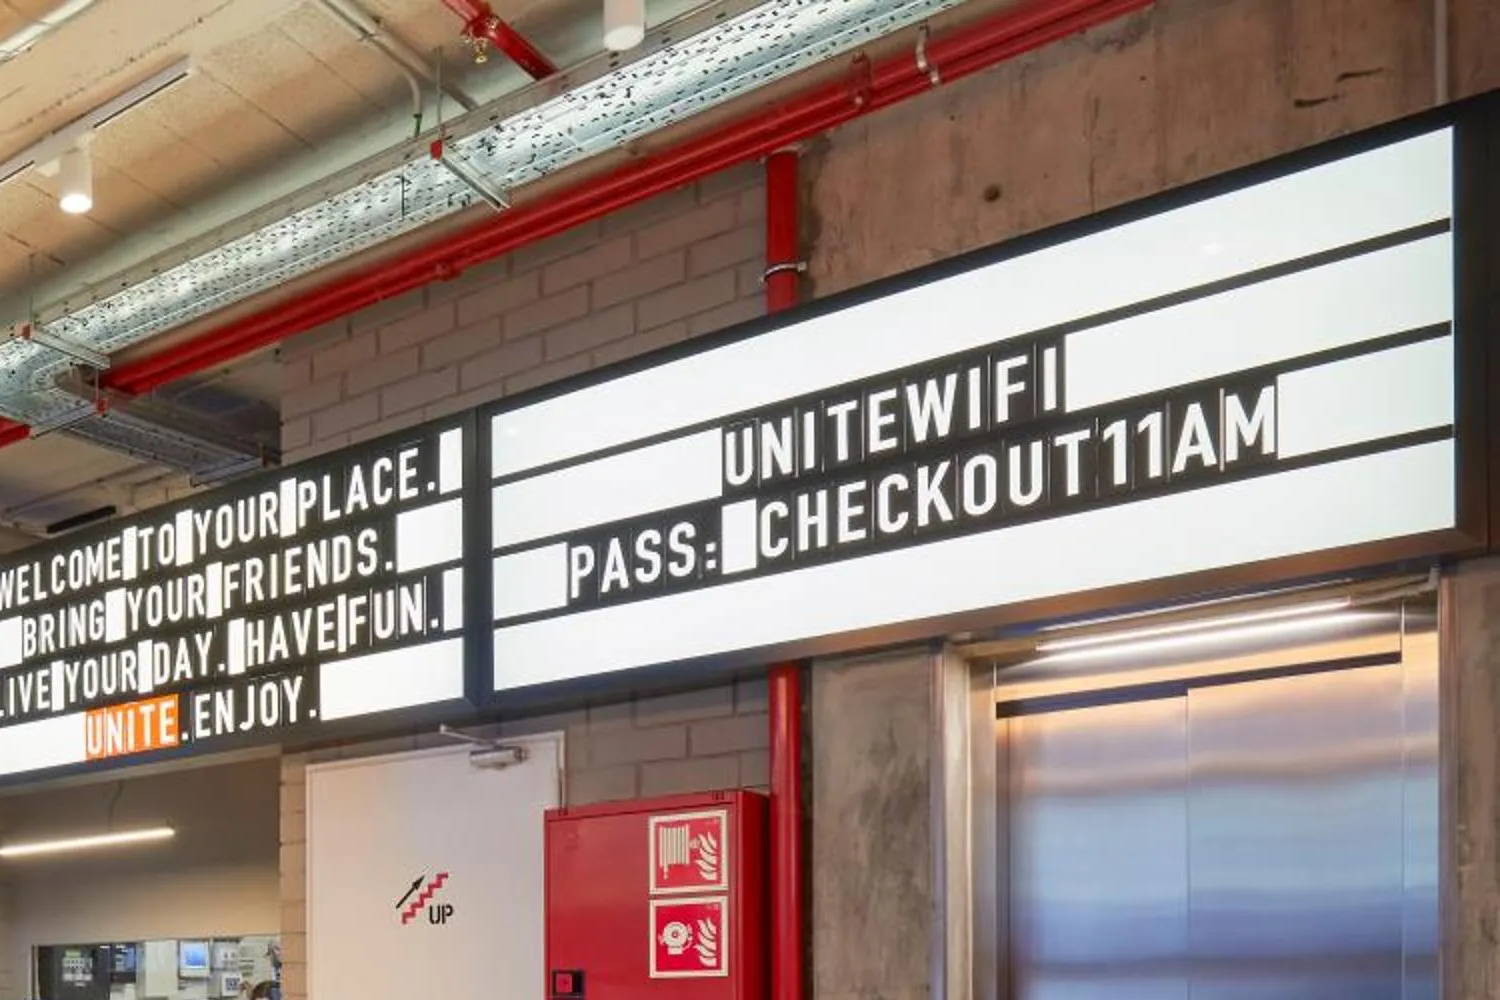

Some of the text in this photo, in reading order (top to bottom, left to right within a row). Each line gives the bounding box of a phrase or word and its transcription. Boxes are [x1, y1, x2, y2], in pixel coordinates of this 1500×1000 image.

[138, 523, 175, 572] TO
[194, 491, 278, 555] YOUR
[299, 447, 435, 529] PLACE.
[570, 521, 717, 599] PASS:
[23, 527, 393, 658] BRING YOUR FRIENDS.
[65, 649, 137, 703] YOUR
[154, 631, 225, 686] DAY.
[247, 603, 335, 667] HAVE
[349, 583, 440, 646] FUN.
[429, 904, 454, 925] UP
